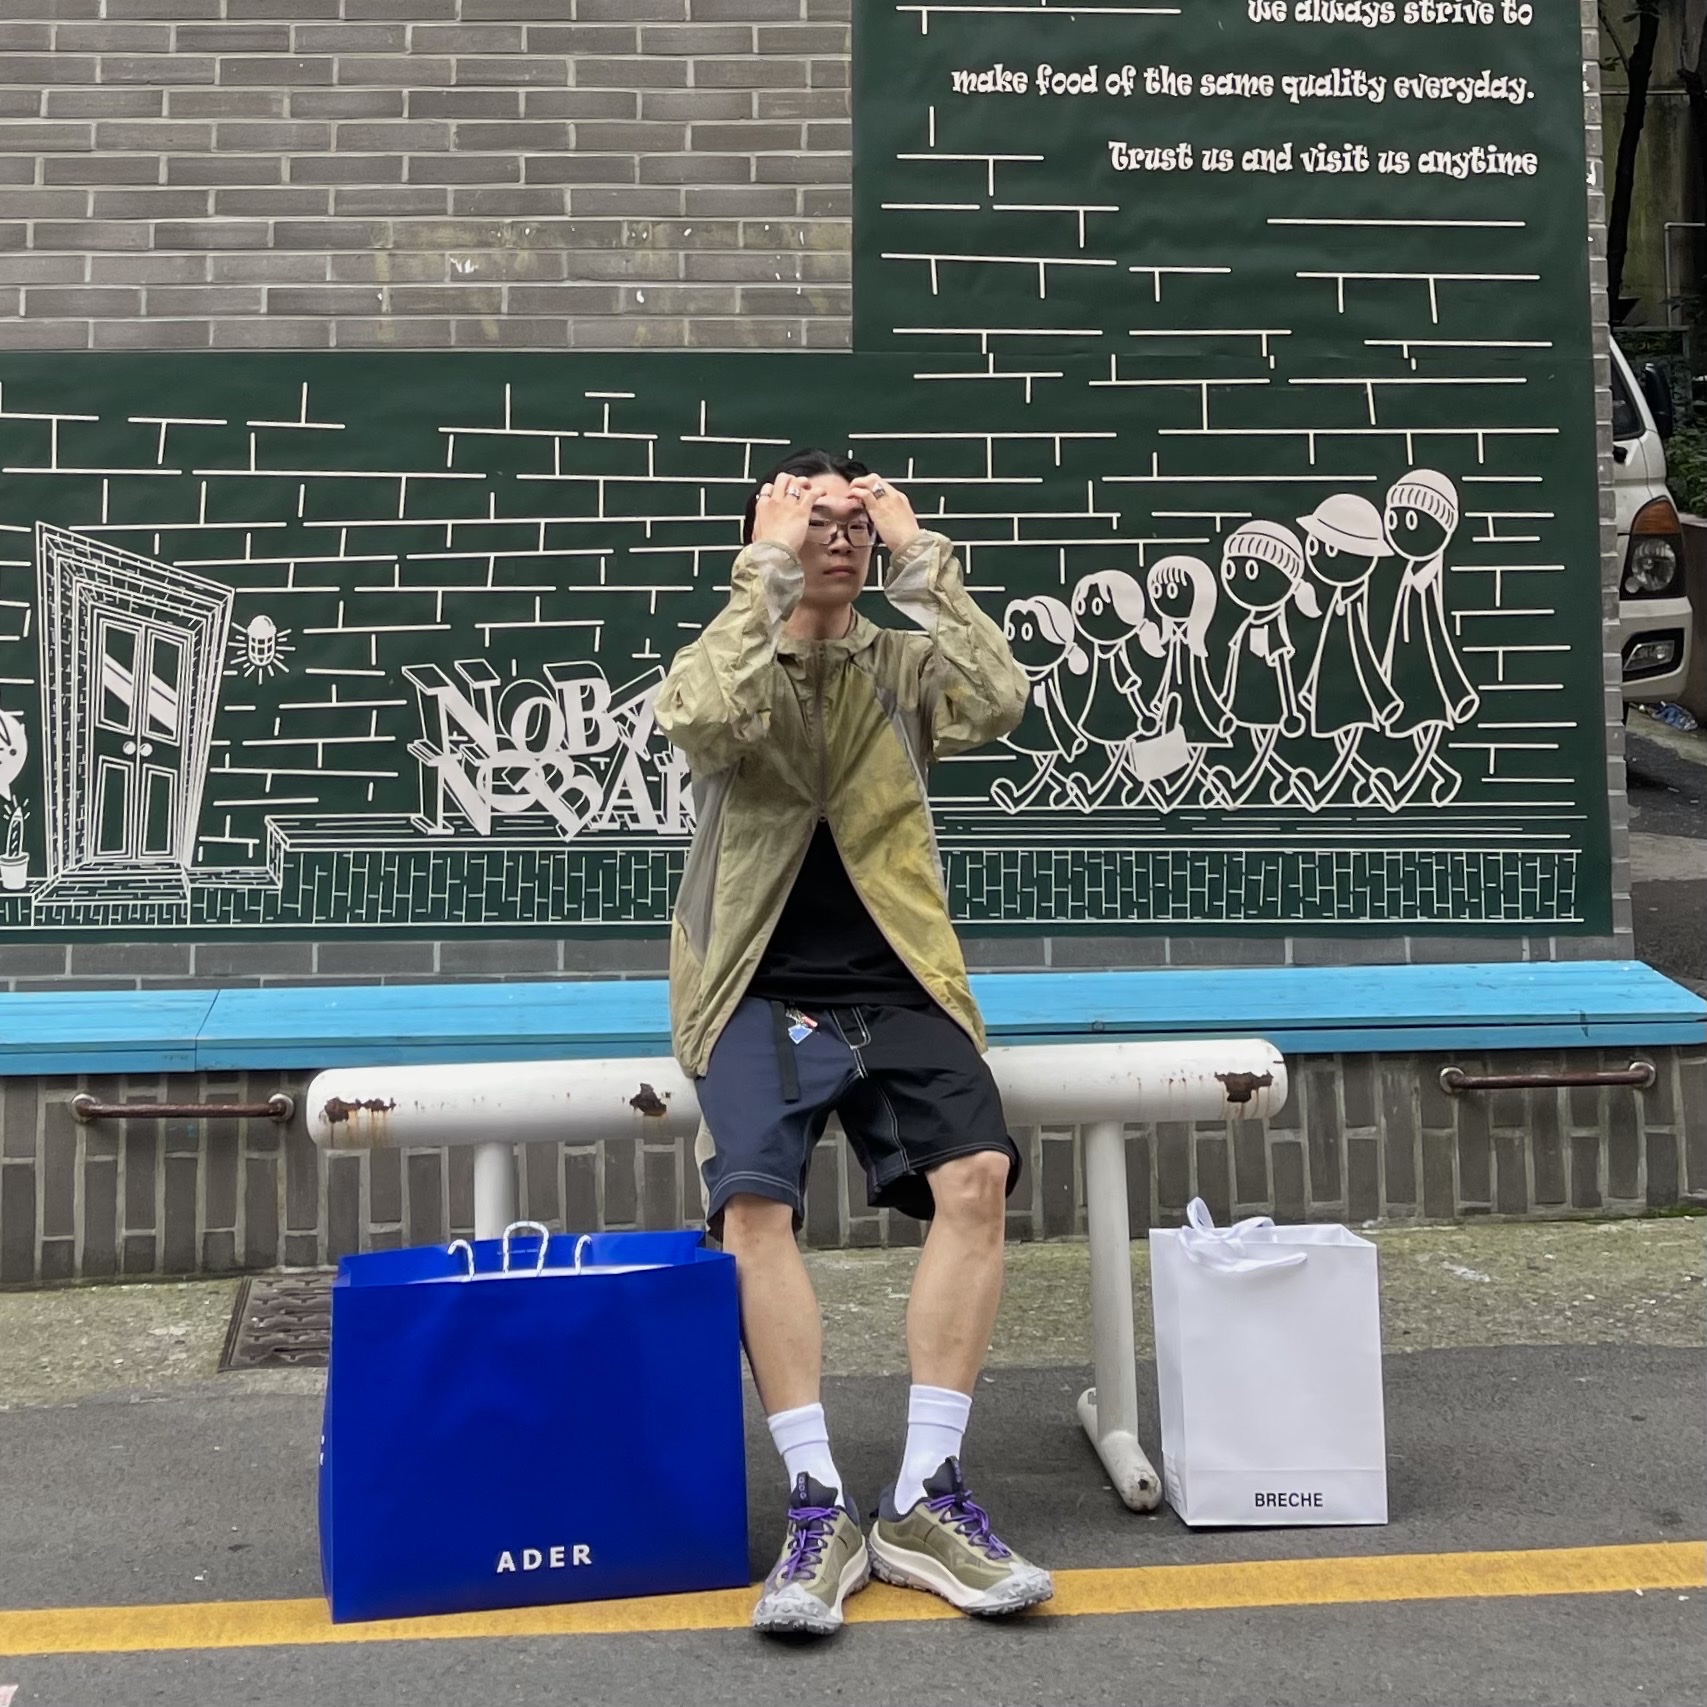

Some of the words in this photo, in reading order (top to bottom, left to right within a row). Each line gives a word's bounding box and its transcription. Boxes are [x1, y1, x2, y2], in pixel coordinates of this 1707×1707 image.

[1295, 0, 1396, 28] always
[1404, 0, 1494, 25] strive
[1501, 0, 1533, 26] to
[951, 63, 1028, 95] make
[1035, 64, 1098, 96] food
[1105, 65, 1137, 97] of
[1144, 65, 1192, 97] the
[1200, 73, 1274, 98] same
[1281, 68, 1387, 104] quality
[1394, 70, 1535, 105] everyday.
[1109, 141, 1194, 171] Trust
[1202, 149, 1234, 172] us
[1242, 143, 1293, 174] and
[1300, 143, 1370, 173] visit
[1378, 150, 1411, 174] us
[1418, 145, 1538, 179] anytime
[1254, 1492, 1323, 1508] BRECHE
[497, 1544, 592, 1573] ADER
